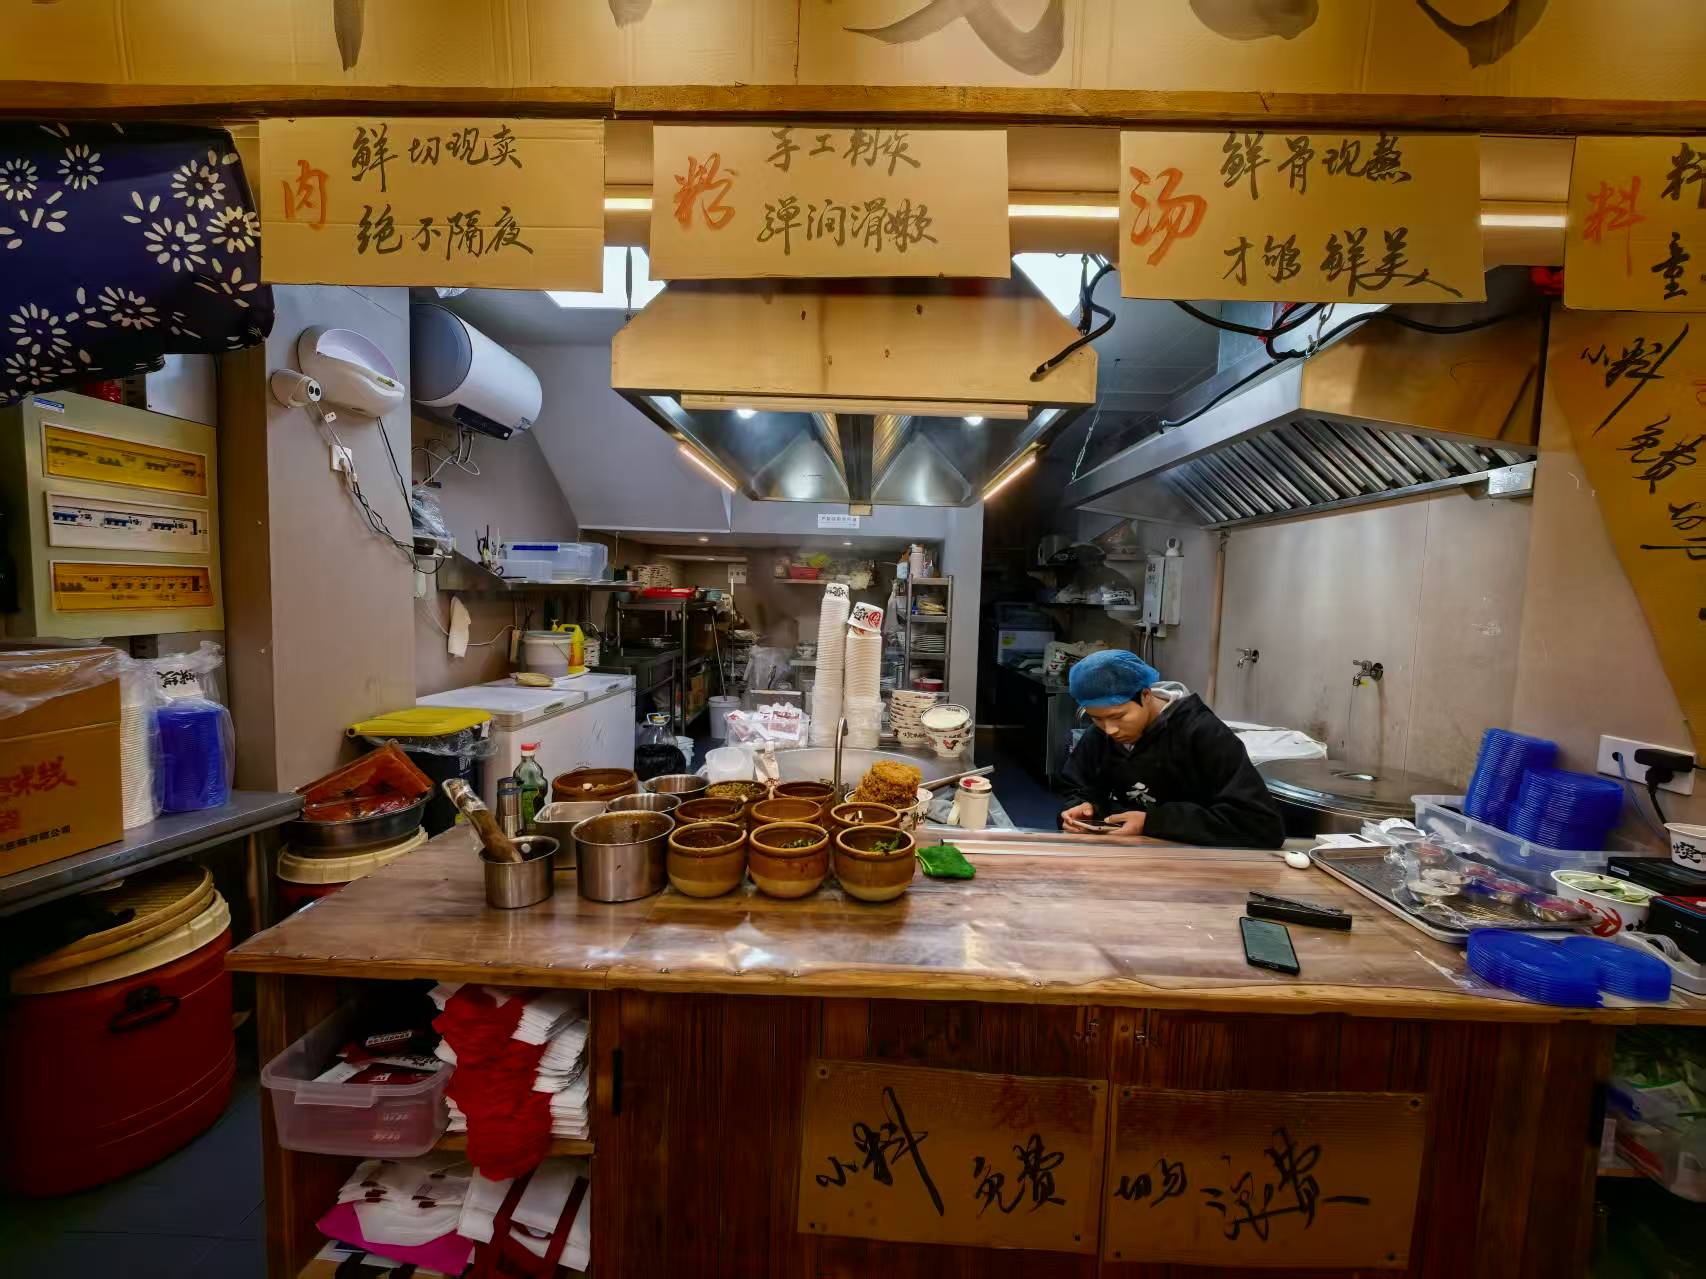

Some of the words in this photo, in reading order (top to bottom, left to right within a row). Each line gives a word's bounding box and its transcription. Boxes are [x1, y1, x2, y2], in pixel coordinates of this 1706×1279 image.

[351, 122, 523, 193] 鲜切现卖
[766, 126, 922, 177] 手工制作
[1219, 130, 1413, 201] 鲜骨现熬
[281, 159, 329, 230] 肉
[673, 152, 739, 231] 粉
[1129, 166, 1208, 266] 汤
[1583, 174, 1648, 279] 料
[354, 203, 534, 261] 绝不隔夜
[1221, 227, 1464, 299] 才够鲜美
